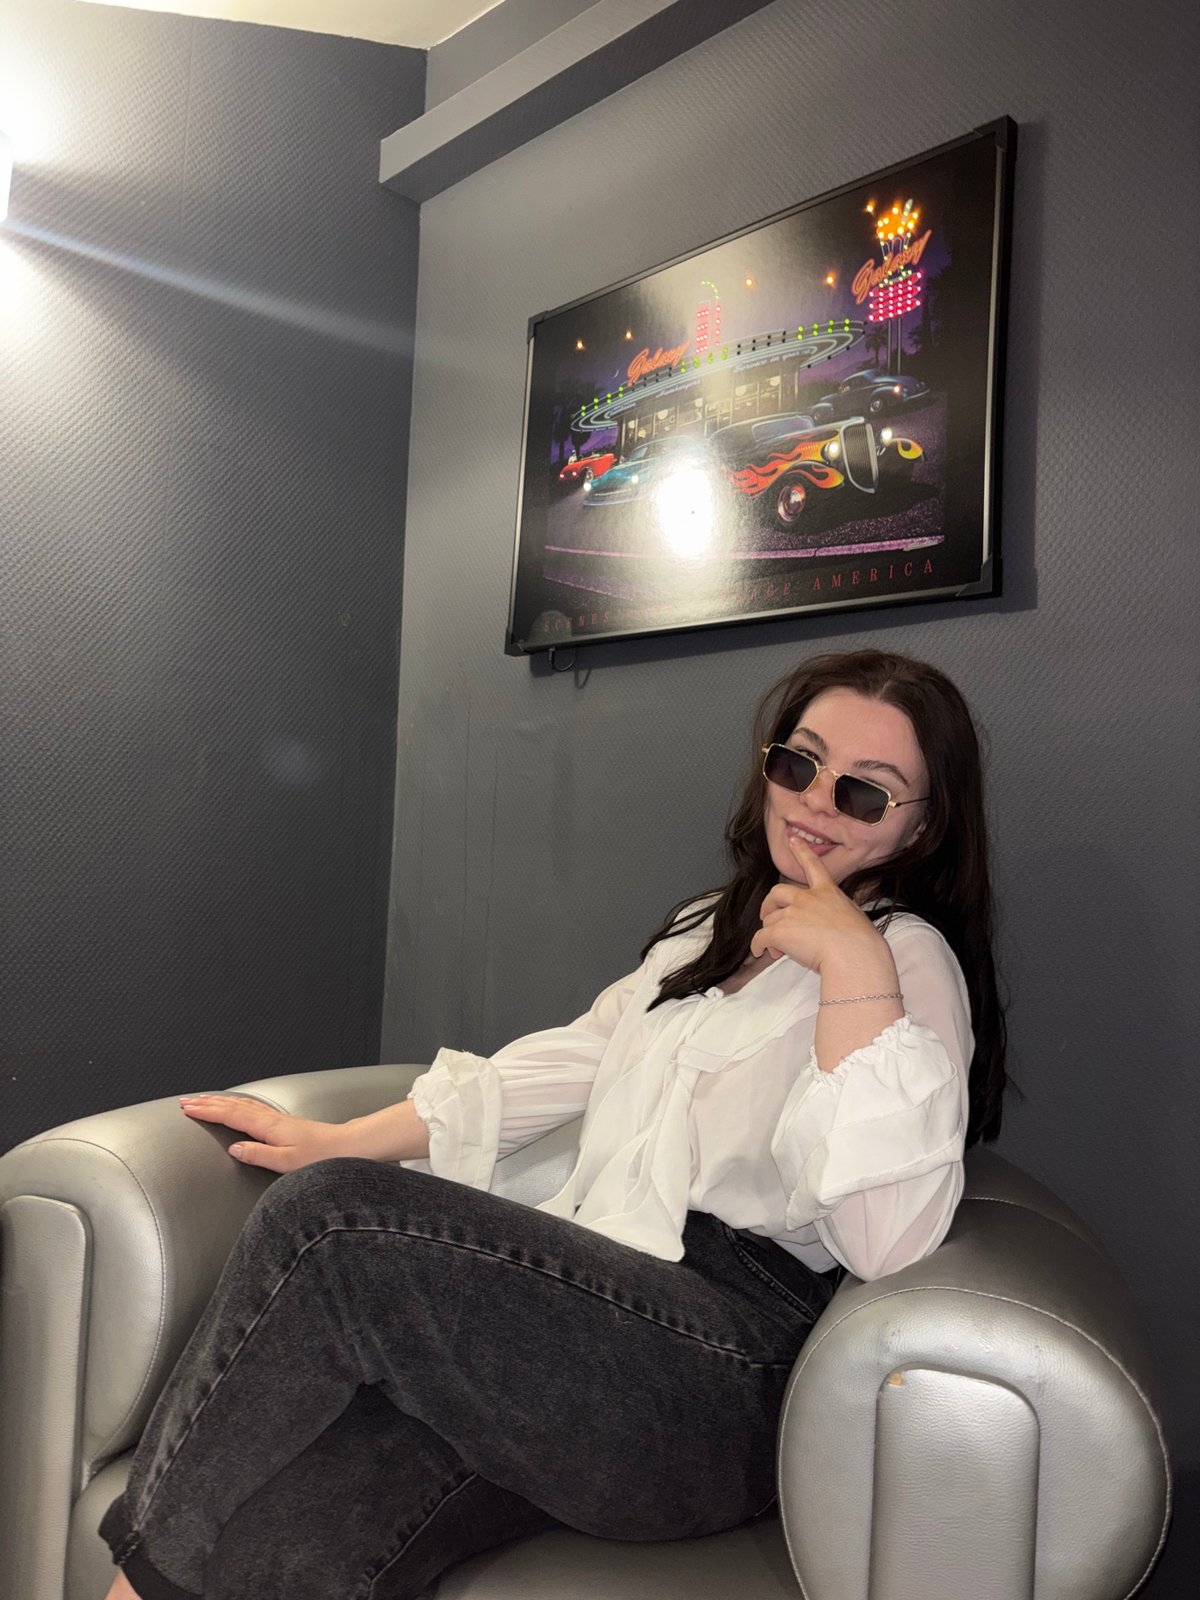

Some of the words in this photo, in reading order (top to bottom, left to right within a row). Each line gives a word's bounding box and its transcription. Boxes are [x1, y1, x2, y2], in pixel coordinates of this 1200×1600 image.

[851, 229, 932, 305] Galaxy
[626, 340, 692, 388] Galaxy
[544, 611, 609, 632] SCENES
[813, 559, 933, 591] AMERICA
